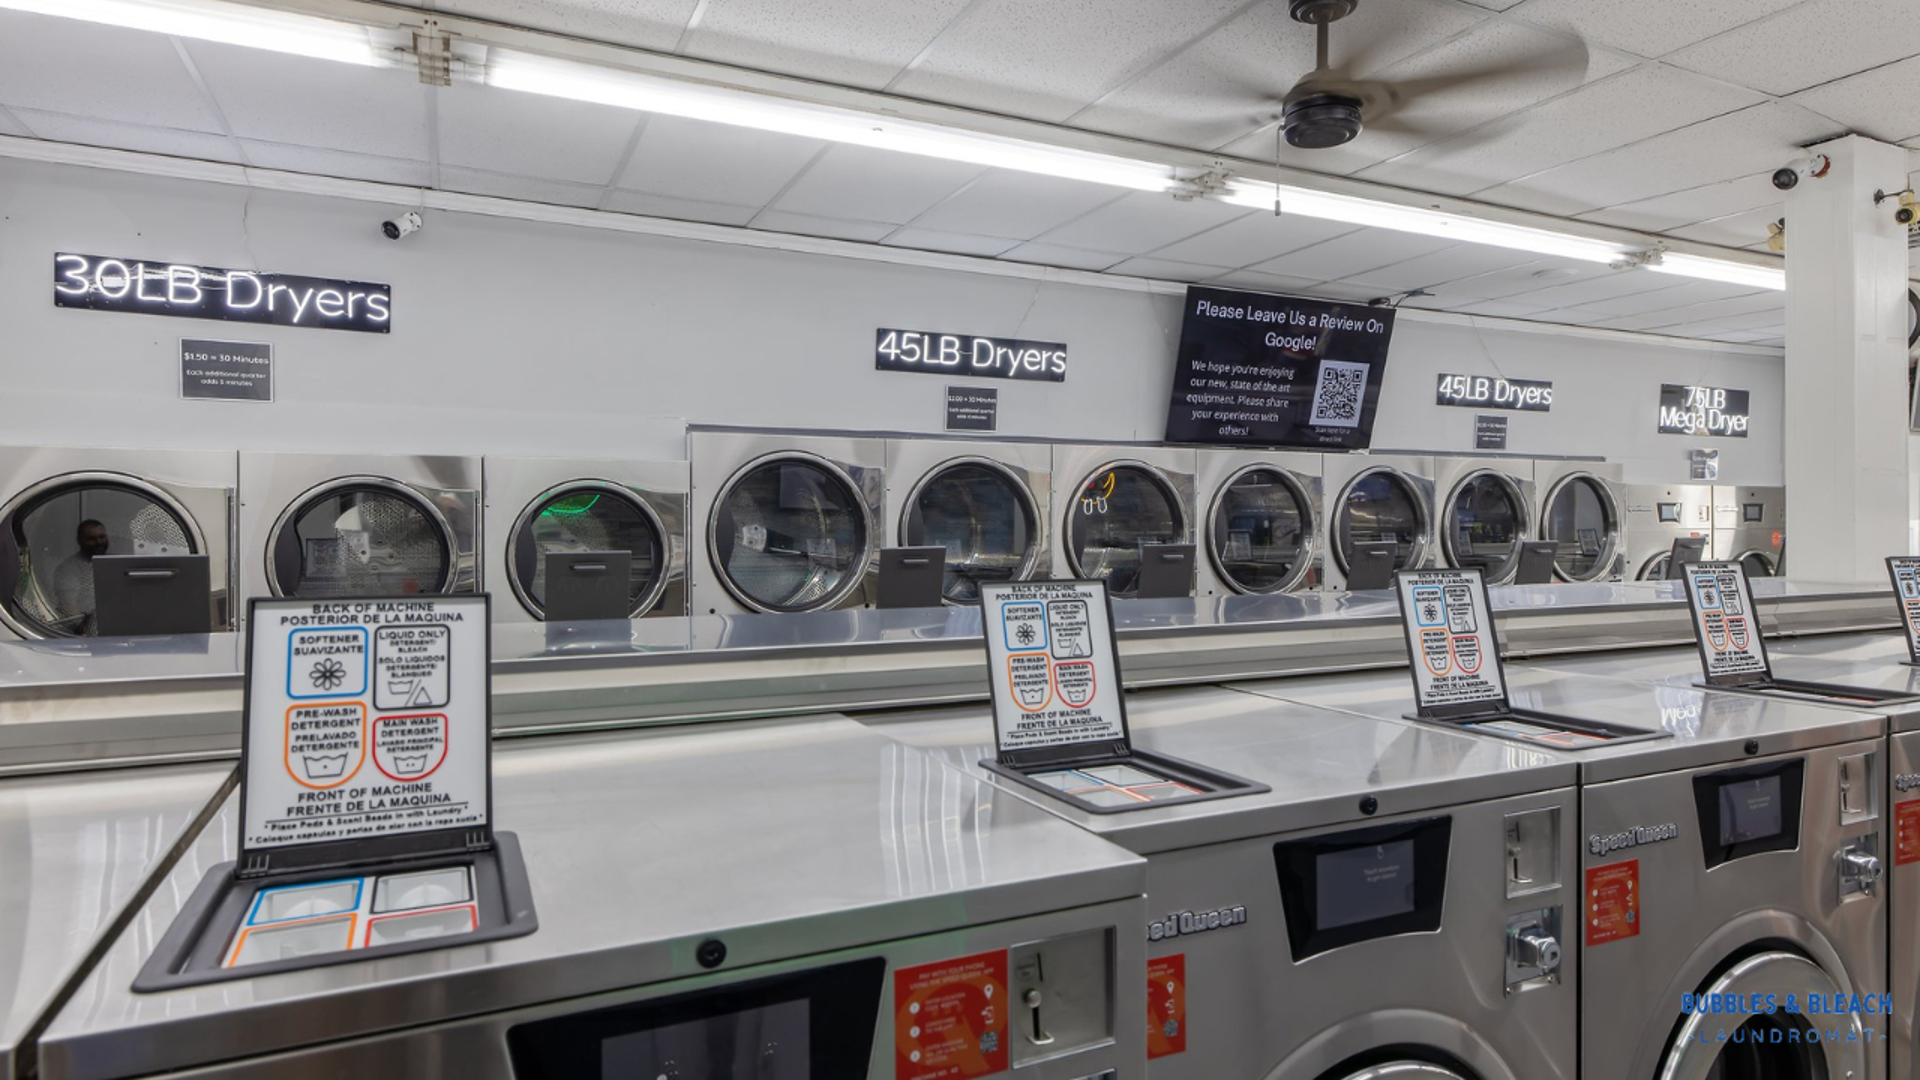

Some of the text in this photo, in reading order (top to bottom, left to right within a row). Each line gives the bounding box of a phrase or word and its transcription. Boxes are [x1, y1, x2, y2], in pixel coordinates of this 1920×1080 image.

[56, 254, 390, 324] 30LB Dryers
[1196, 300, 1384, 334] Please Leave Us a Review On
[1265, 332, 1317, 351] Google!
[233, 355, 270, 364] Minutes
[878, 331, 1067, 377] 45LB Dryers
[186, 368, 203, 376] Each
[204, 370, 239, 378] additional
[1191, 360, 1295, 381] We hope you're enjoying
[1190, 378, 1206, 387] our
[1230, 379, 1251, 390] state
[1252, 381, 1263, 391] of
[1263, 381, 1277, 392] the
[1278, 384, 1291, 393] art
[1438, 375, 1553, 408] 45LB Dryers
[1237, 396, 1265, 407] Please
[1265, 397, 1289, 408] share
[1191, 410, 1279, 422] your experience with
[1659, 406, 1750, 435] Mega Dryer
[1218, 425, 1250, 436] others!
[1011, 585, 1032, 593] BACK
[1045, 584, 1076, 592] MACHINE
[996, 593, 1038, 601] POSTERIOR
[1039, 592, 1048, 600] DE
[1061, 591, 1093, 599] MAQUINA
[313, 602, 435, 614] BACK OF MACHINE
[1006, 606, 1040, 614] SOFTENER
[280, 612, 463, 626] POSTERIOR DE LA MAQUINA
[299, 634, 359, 645] SOFTENER
[379, 630, 446, 641] LIQUID ONLY
[294, 645, 364, 656] SUAVIZANTE
[378, 655, 446, 665] SOLO LIQUIDOS
[1011, 664, 1048, 673] DETERGENT
[296, 708, 357, 719] PRE-WASH
[1021, 709, 1092, 722] FRONT OF MACHINE
[291, 718, 361, 731] DETERGENT
[382, 717, 438, 728] MAIN WASH
[1016, 716, 1103, 730] FRENTE DE LA MAQUINA
[295, 731, 356, 743] PRELAVADO
[381, 727, 439, 738] DETERGENT
[291, 741, 360, 753] DETERGENTE
[376, 737, 444, 748] LAVADO PRINCIPAL
[386, 744, 434, 753] DETERGENTE
[297, 782, 433, 804] FRONT OF MACHINE
[287, 793, 452, 817] FRENTE DE LA MAQUINA
[271, 806, 463, 832] Place Pods & Scent Beads in with Laundry
[256, 833, 295, 845] Coloque
[296, 829, 336, 840] capsulas
[339, 829, 345, 837] y
[1589, 823, 1678, 857] Speed Queen
[1179, 904, 1247, 935] Queen
